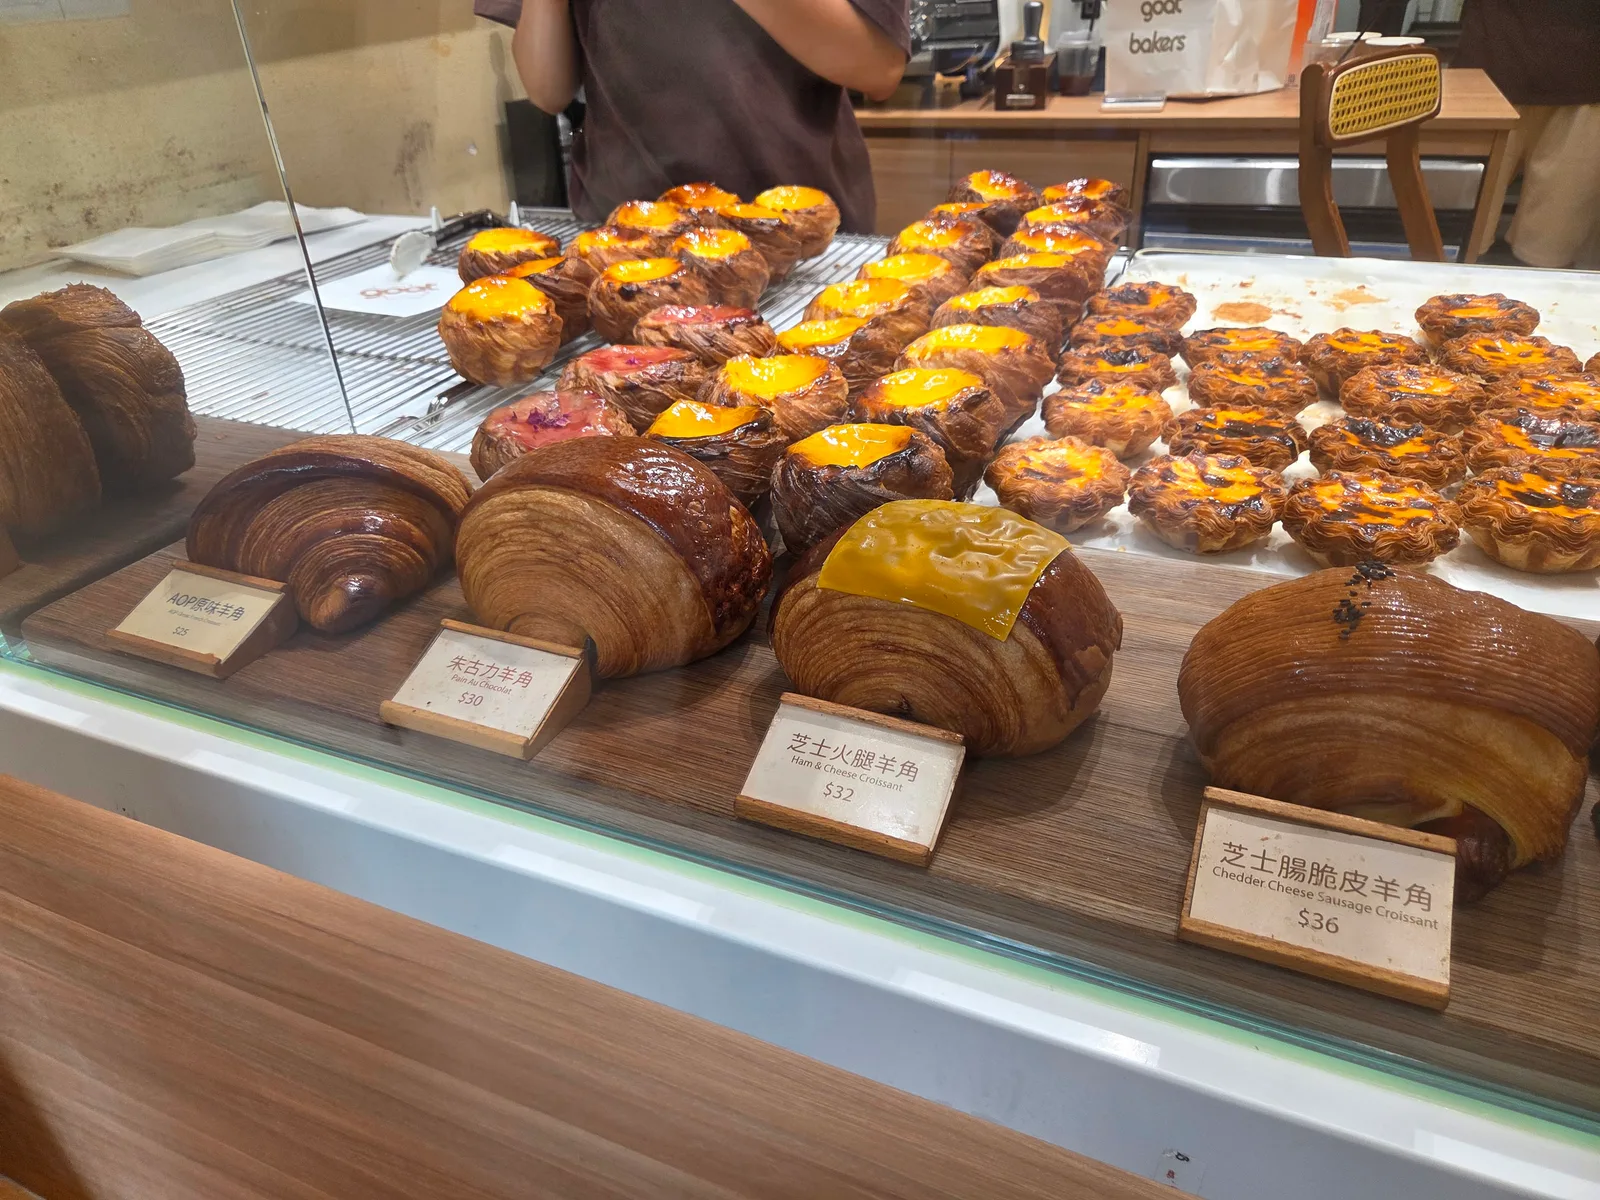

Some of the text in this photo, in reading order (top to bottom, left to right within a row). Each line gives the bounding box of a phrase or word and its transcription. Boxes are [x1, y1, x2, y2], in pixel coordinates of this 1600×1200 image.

[1129, 30, 1186, 54] bakers
[166, 592, 245, 621] AOP原味羊角
[172, 626, 189, 636] $25
[446, 655, 533, 688] 朱古力羊角
[451, 674, 512, 695] Pain Au Chocolat
[458, 691, 484, 707] $30
[787, 733, 918, 782] 芝士火腿羊角
[791, 755, 904, 793] Ham & Cheese Croissant
[823, 781, 855, 803] $32
[1220, 841, 1432, 913] 芝士腸脆皮羊角
[1212, 865, 1439, 931] Chedder Cheese Sausage Croissant
[1298, 907, 1340, 934] $36
